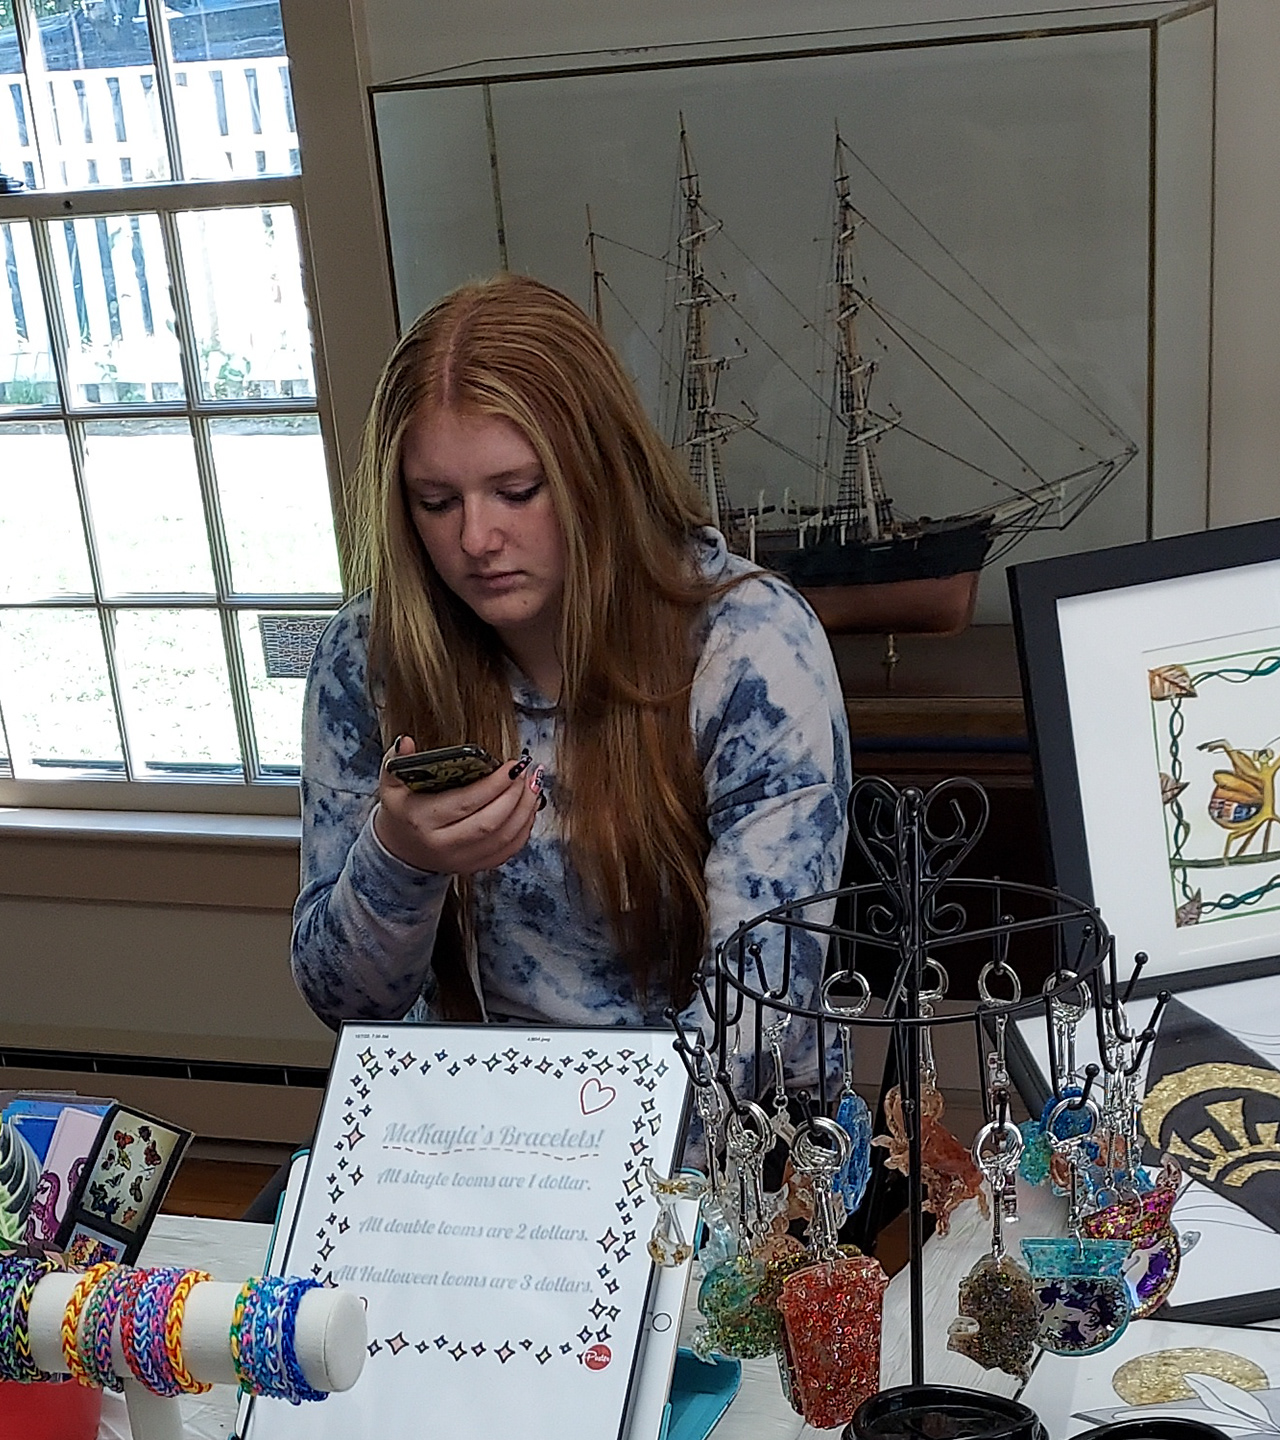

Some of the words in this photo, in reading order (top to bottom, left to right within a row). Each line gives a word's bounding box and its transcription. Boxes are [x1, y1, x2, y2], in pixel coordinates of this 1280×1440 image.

[382, 1122, 493, 1149] MaKayla's
[499, 1125, 606, 1149] Bracelets!
[377, 1168, 400, 1185] All
[402, 1169, 448, 1189] single
[452, 1172, 497, 1188] looms
[498, 1176, 525, 1188] are
[538, 1174, 592, 1191] dollar.
[359, 1216, 381, 1234] All
[384, 1219, 435, 1235] double
[437, 1220, 484, 1238] looms
[486, 1226, 513, 1239] are
[515, 1223, 527, 1239] 2
[529, 1224, 589, 1241] dollars.
[333, 1265, 358, 1281] All
[359, 1265, 438, 1285] Halloween
[441, 1271, 487, 1288] looms
[490, 1277, 518, 1290] are
[520, 1274, 532, 1291] 3
[534, 1275, 594, 1293] dollars.
